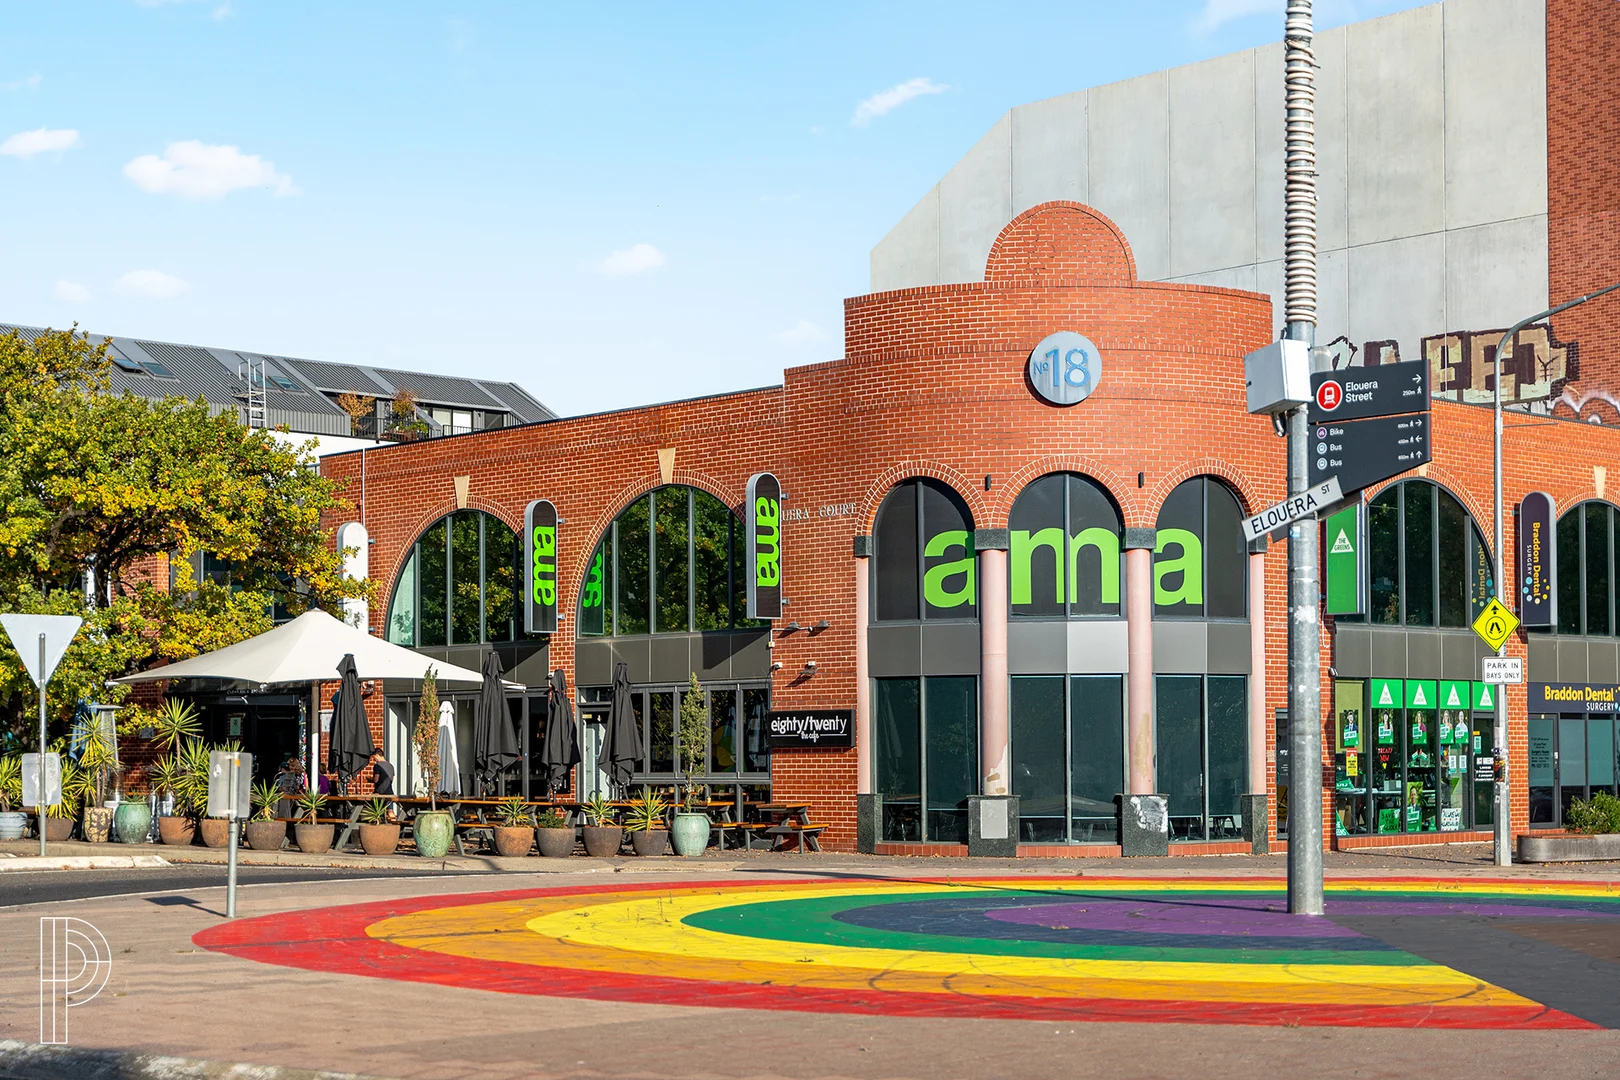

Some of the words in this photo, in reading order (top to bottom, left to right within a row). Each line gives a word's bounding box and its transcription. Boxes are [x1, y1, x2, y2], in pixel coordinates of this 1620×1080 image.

[1045, 348, 1091, 387] 18
[1345, 380, 1378, 392] Elouera
[1345, 391, 1373, 403] Street
[1329, 428, 1344, 436] Bike
[1329, 443, 1342, 451] Bus
[1329, 459, 1342, 467] Bus
[781, 508, 810, 521] UERA
[817, 502, 857, 517] COURT
[1251, 493, 1318, 534] ELOUERA
[1320, 483, 1331, 495] ST
[756, 496, 779, 587] ama
[1532, 522, 1541, 563] Braddon
[532, 525, 556, 607] ama
[924, 527, 1203, 608] ama
[1533, 565, 1541, 597] Dental
[1544, 685, 1583, 701] Braddon
[1585, 686, 1614, 702] Dental
[1586, 702, 1615, 711] SURGERY
[771, 715, 847, 734] eighty/twenty
